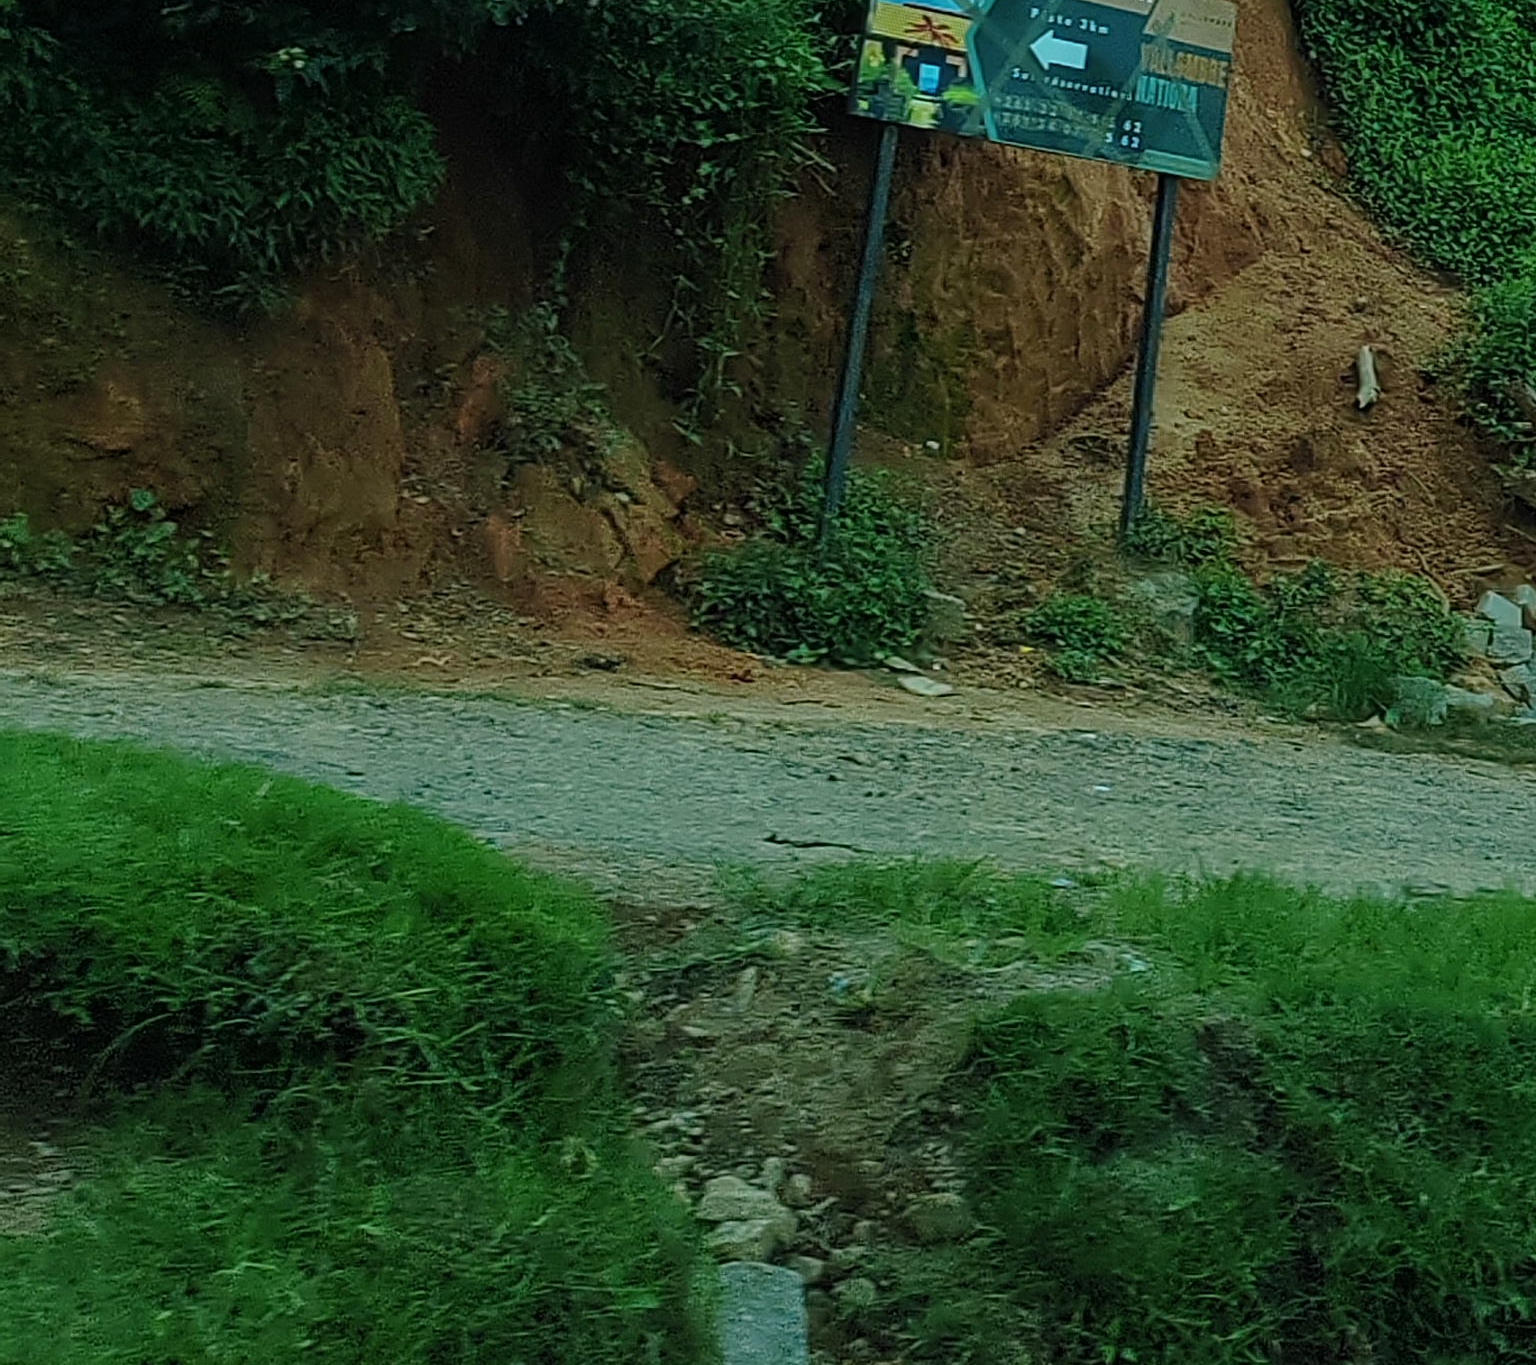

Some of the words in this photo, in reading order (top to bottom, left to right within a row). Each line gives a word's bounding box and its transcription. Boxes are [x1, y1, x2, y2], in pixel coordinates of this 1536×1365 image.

[1079, 18, 1109, 35] 3km
[1122, 119, 1143, 135] 62
[1120, 135, 1141, 149] 62
